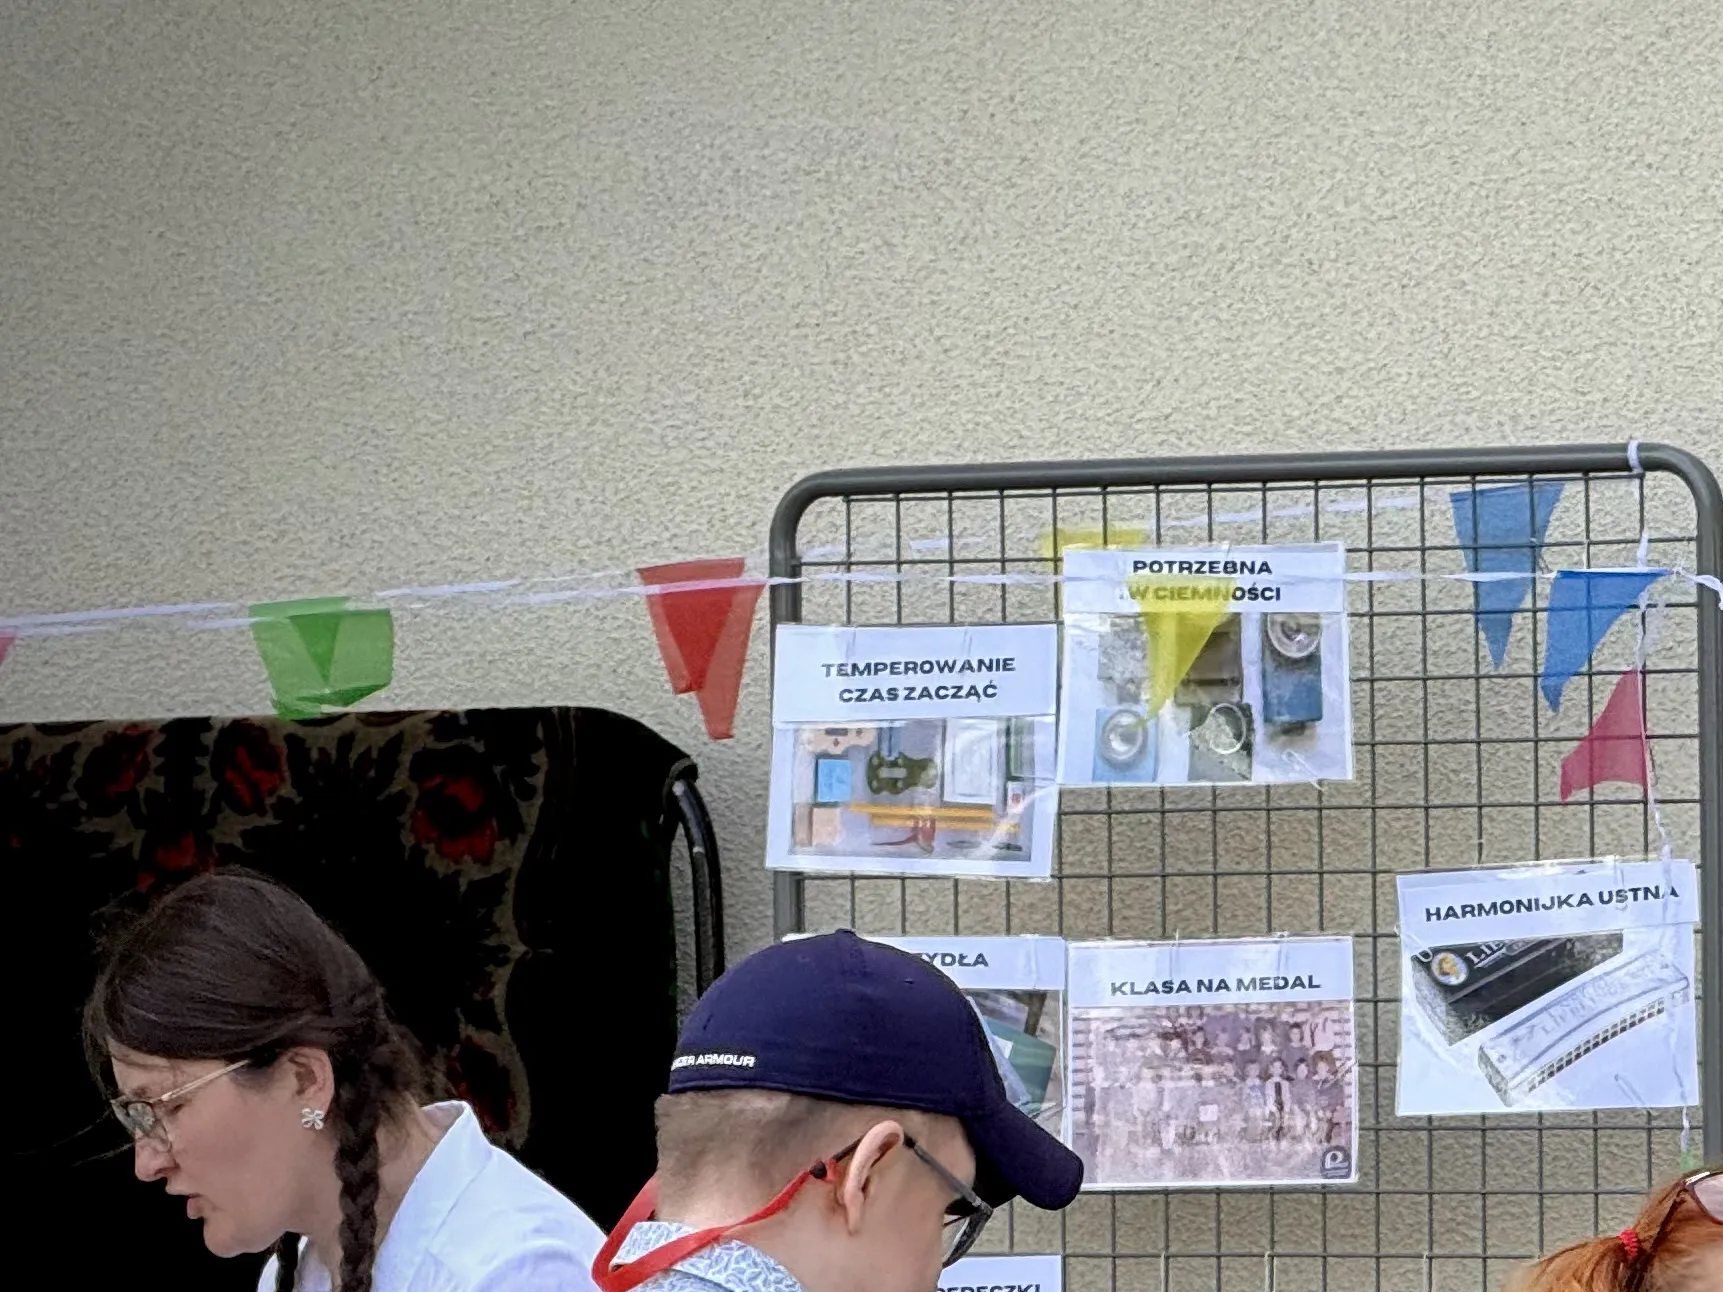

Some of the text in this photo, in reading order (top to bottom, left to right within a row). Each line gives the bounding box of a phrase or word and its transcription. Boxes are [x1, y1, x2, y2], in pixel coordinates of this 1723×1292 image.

[1132, 559, 1273, 575] POTRZEBNA
[1127, 582, 1281, 601] W CIEMNOŚCI
[820, 656, 1017, 678] TEMPEROWANIE
[838, 679, 998, 703] CZAS ZACZĄĆ
[1424, 885, 1680, 922] HARMONIJKA USTNA
[914, 952, 989, 967] YDŁA
[1110, 974, 1322, 996] KLASA NA MEDAL
[695, 1053, 756, 1068] ARMOUR
